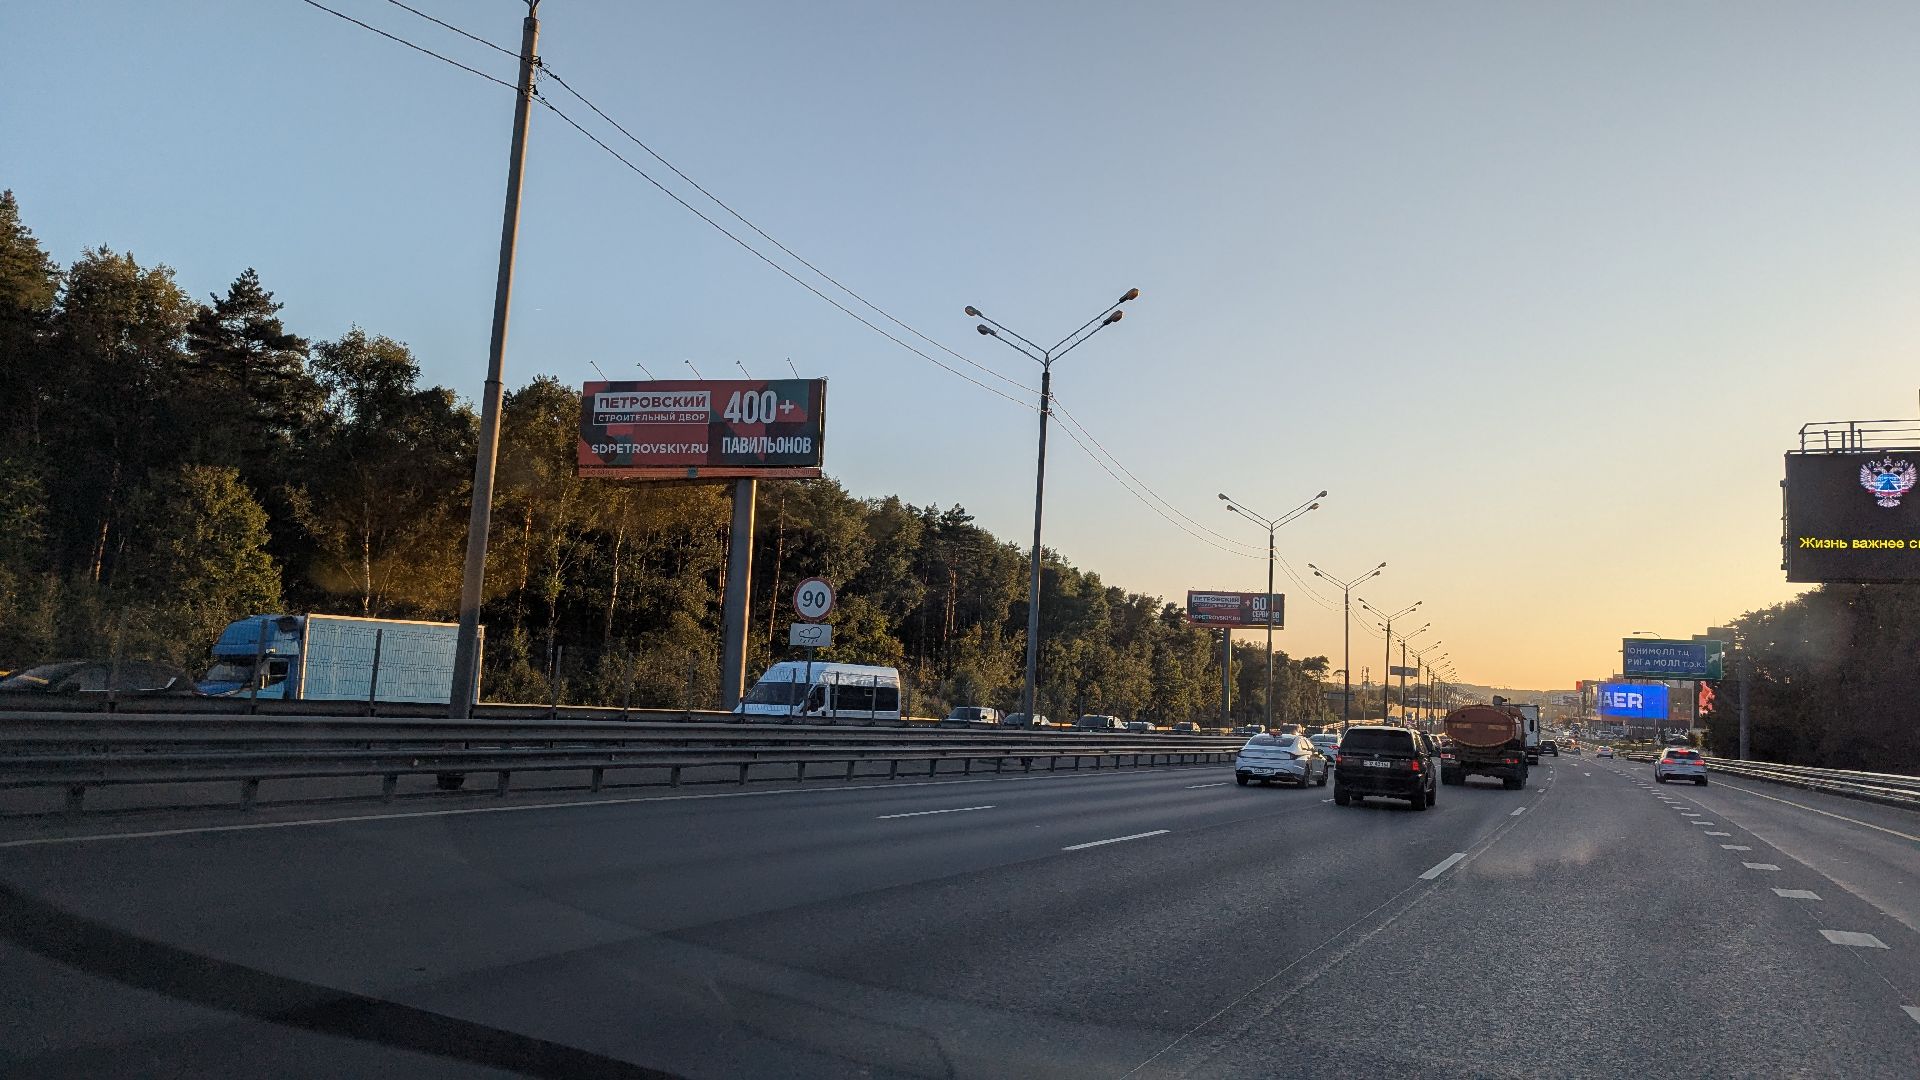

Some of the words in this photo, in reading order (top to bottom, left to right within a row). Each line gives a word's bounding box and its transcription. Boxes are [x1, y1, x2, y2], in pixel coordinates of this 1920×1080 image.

[599, 393, 706, 409] ПЕТРОВСКИЙ
[723, 390, 795, 424] 400+
[598, 411, 676, 423] СТРОИТЕЛЬНЫЙ
[678, 413, 705, 423] ДВОР
[591, 443, 709, 455] SDPETROVSKIY.RU
[722, 436, 812, 454] ПАВИЛЬОНОВ
[1799, 537, 1848, 549] Жизнь
[1852, 539, 1905, 549] важнее
[1909, 539, 1920, 549] с
[802, 590, 826, 609] 90
[1252, 610, 1280, 619] СЕРВИОВ
[1627, 647, 1675, 656] ЮНИМОЛЛ
[1627, 658, 1651, 667] РИГА
[1653, 659, 1680, 667] МОЛЛ
[1598, 691, 1643, 709] AER
